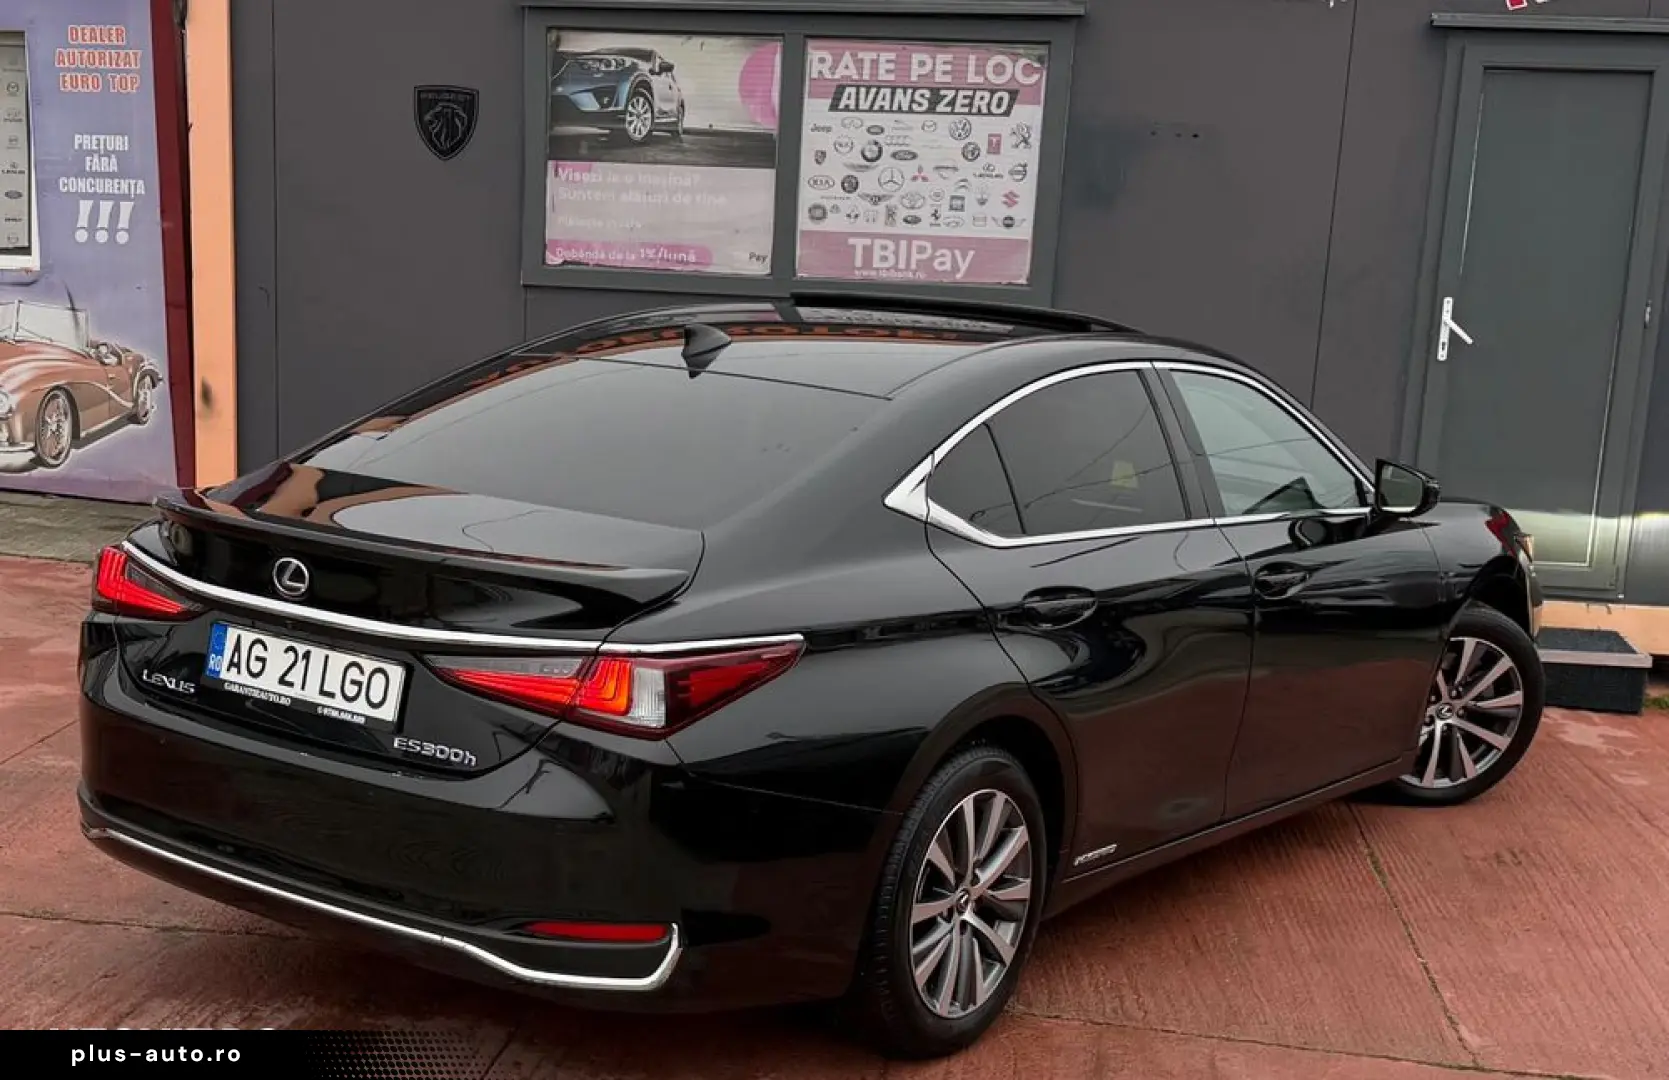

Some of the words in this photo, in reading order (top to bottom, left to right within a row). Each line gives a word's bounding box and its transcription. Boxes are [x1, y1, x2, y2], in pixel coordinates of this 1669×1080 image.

[68, 25, 126, 45] DEALER
[55, 48, 141, 68] AUTORIZAT
[809, 51, 896, 81] RATE
[910, 53, 953, 83] PE
[966, 54, 1041, 85] LOC
[60, 73, 102, 92] EURO
[108, 73, 140, 92] TOP
[838, 86, 931, 113] AVANS
[936, 89, 1010, 115] ZERO
[847, 238, 976, 280] TBIPay
[208, 651, 223, 672] RO
[226, 632, 269, 680] AG
[277, 645, 312, 692] 21
[318, 653, 391, 710] LGO
[142, 669, 196, 694] LEXUS
[393, 737, 477, 767] ES300h
